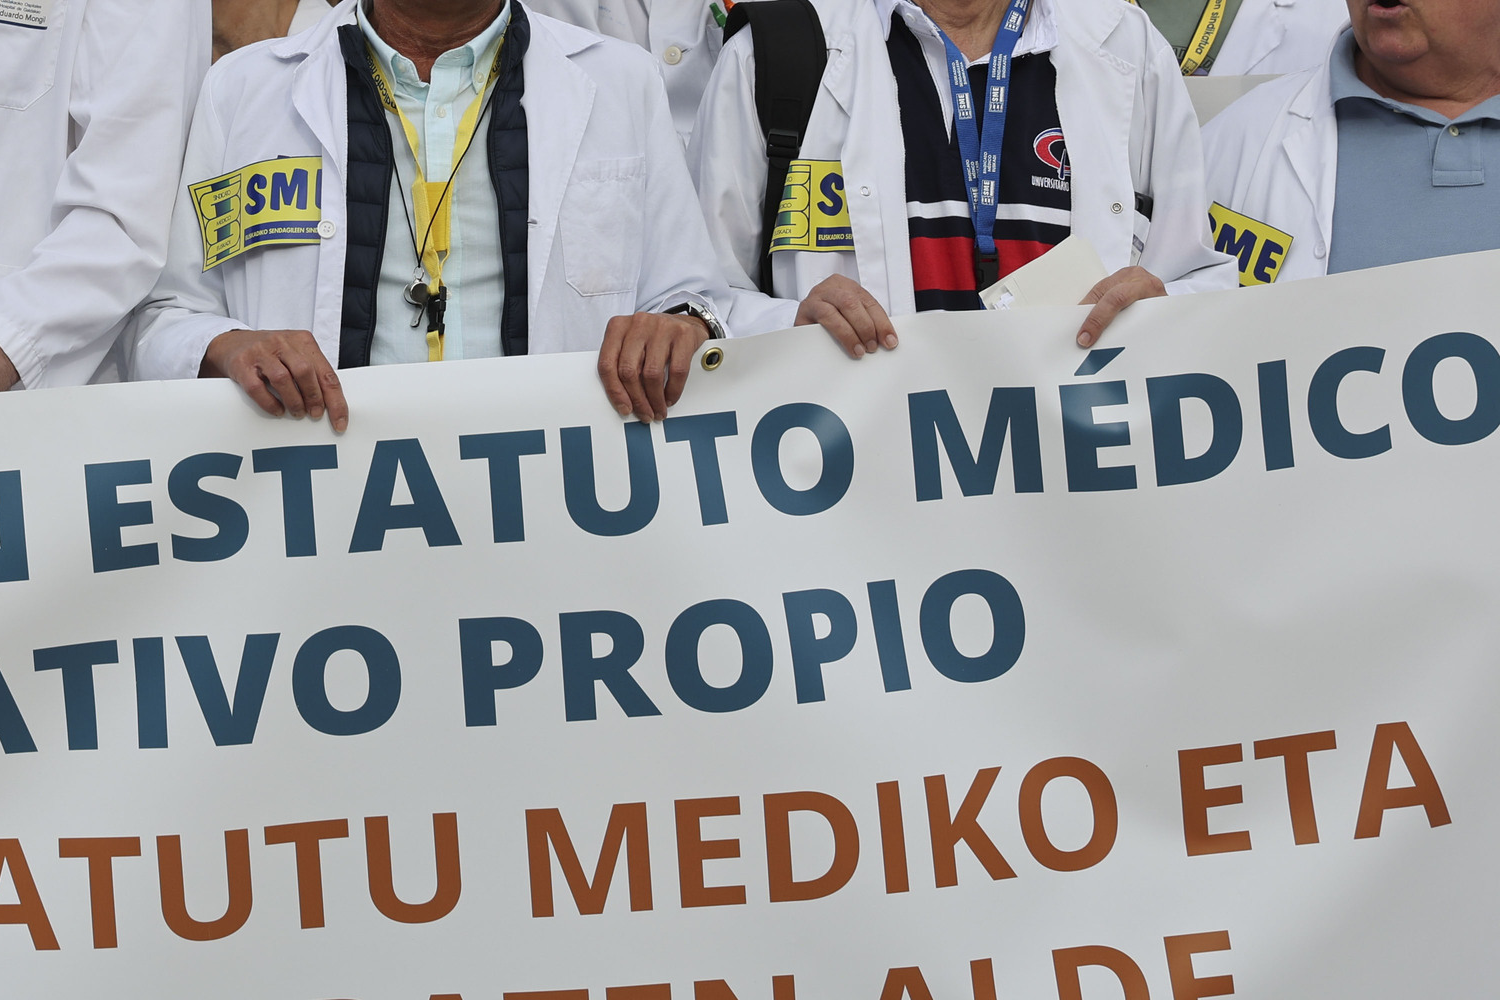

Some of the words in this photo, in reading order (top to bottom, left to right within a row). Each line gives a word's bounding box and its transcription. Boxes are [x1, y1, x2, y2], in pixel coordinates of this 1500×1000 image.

[1195, 11, 1220, 55] sindikatua
[1031, 175, 1069, 192] UNIVERSITARIO
[268, 226, 305, 235] SENDAGILEEN
[818, 233, 844, 241] EUSKADIKO
[85, 401, 854, 574] ESTATUTO
[909, 332, 1500, 503] MÉDICO
[459, 568, 1027, 728] PROPIO
[525, 756, 1119, 918] MEDIKO
[1177, 721, 1452, 857] ETA
